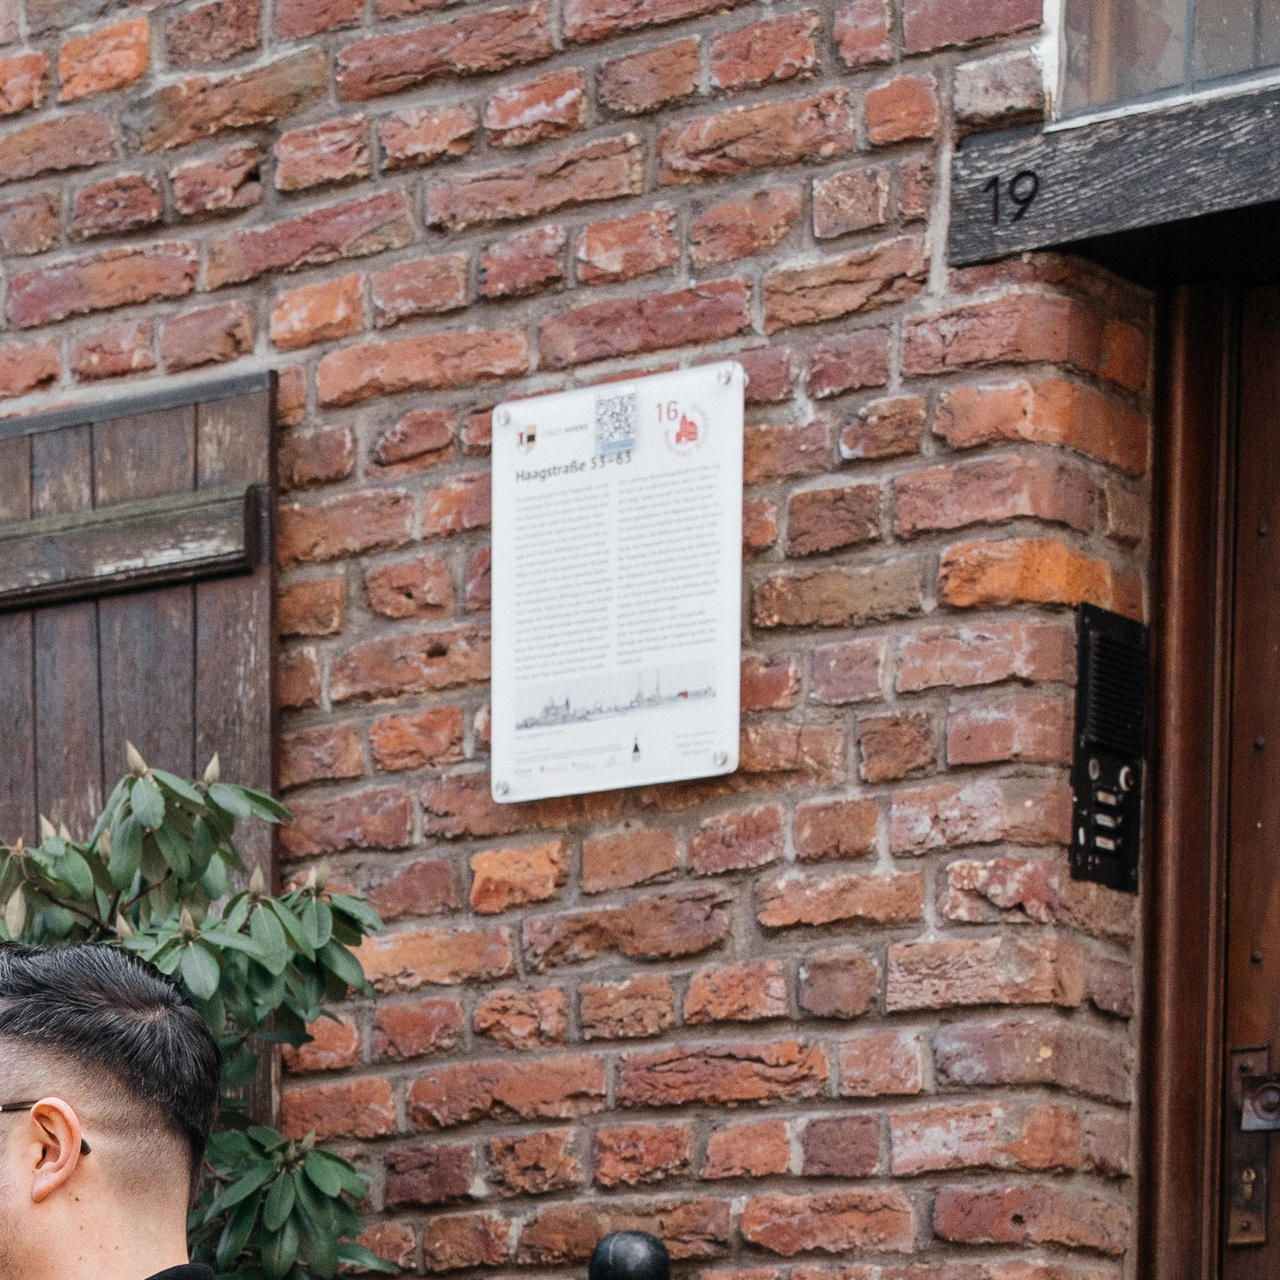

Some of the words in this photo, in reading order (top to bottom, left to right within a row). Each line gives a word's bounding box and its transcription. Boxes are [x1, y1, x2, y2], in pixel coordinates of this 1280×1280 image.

[982, 170, 1039, 226] 19
[655, 400, 678, 423] 16
[516, 460, 586, 482] Haagstraße
